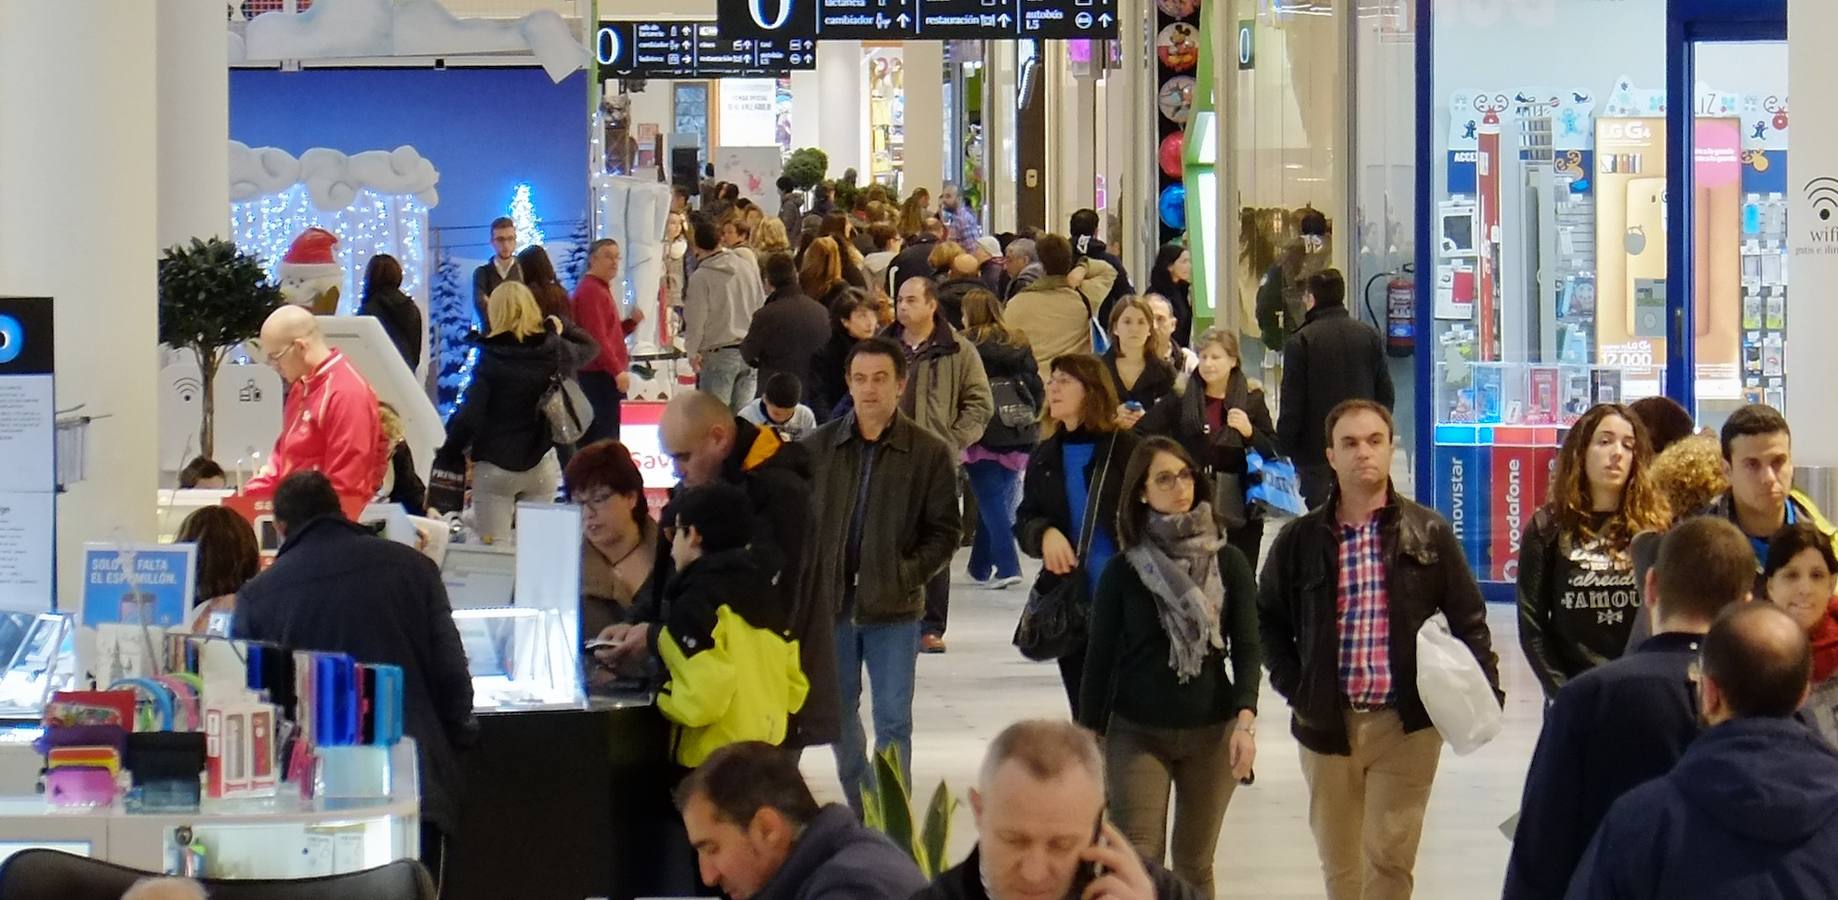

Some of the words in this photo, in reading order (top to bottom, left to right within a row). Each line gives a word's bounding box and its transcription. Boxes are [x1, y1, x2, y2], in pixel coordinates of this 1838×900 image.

[824, 14, 874, 25] cambiador
[925, 14, 980, 25] restauración
[1025, 9, 1064, 20] autobús
[1026, 20, 1040, 30] L5
[597, 27, 620, 65] 0
[1450, 457, 1464, 540] movistar
[1506, 459, 1520, 554] vodafone
[136, 559, 169, 572] FALTA
[1572, 571, 1637, 589] alread
